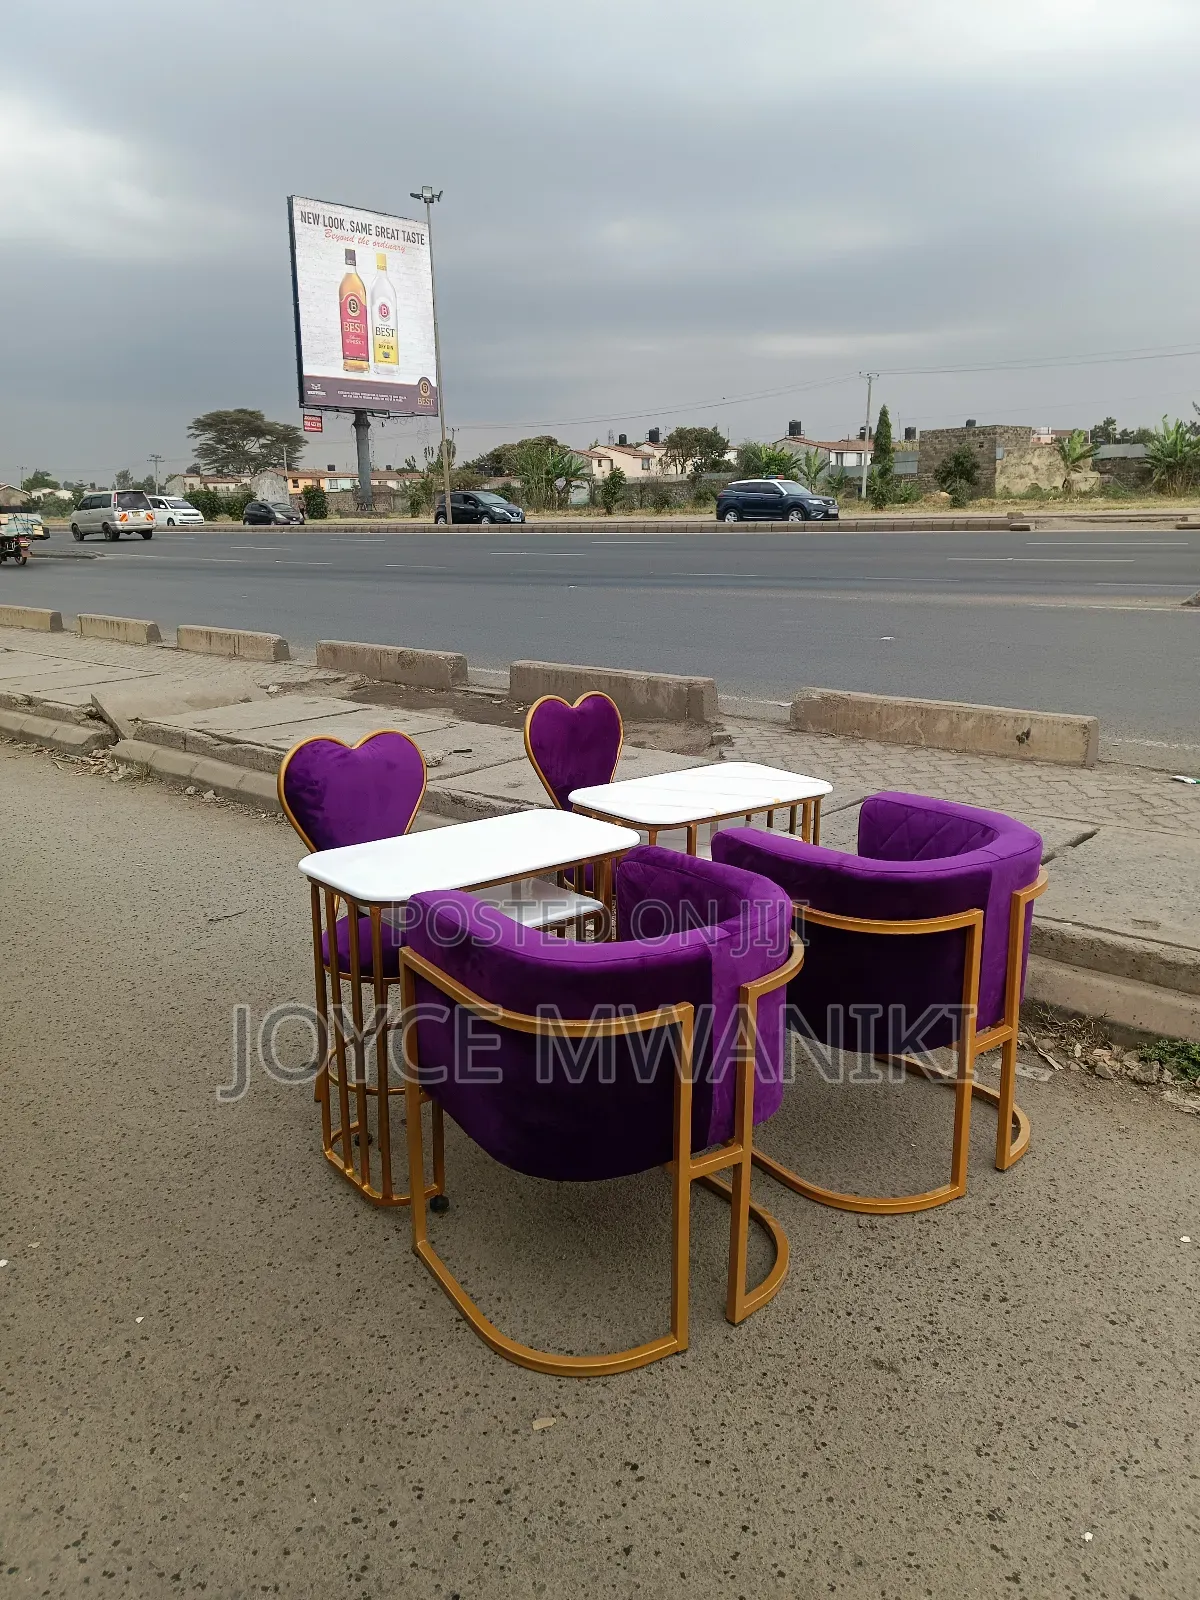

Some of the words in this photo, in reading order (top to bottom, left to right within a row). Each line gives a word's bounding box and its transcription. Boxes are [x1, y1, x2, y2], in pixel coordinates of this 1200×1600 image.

[300, 210, 320, 226] NEW
[350, 220, 373, 236] SAME
[375, 225, 400, 241] GREAT
[401, 230, 425, 246] TASTE
[324, 228, 355, 243] Beyond
[358, 235, 370, 246] the
[372, 240, 406, 254] ordinary
[343, 321, 366, 333] BEST
[376, 326, 395, 337] BEST
[417, 397, 435, 406] BEST
